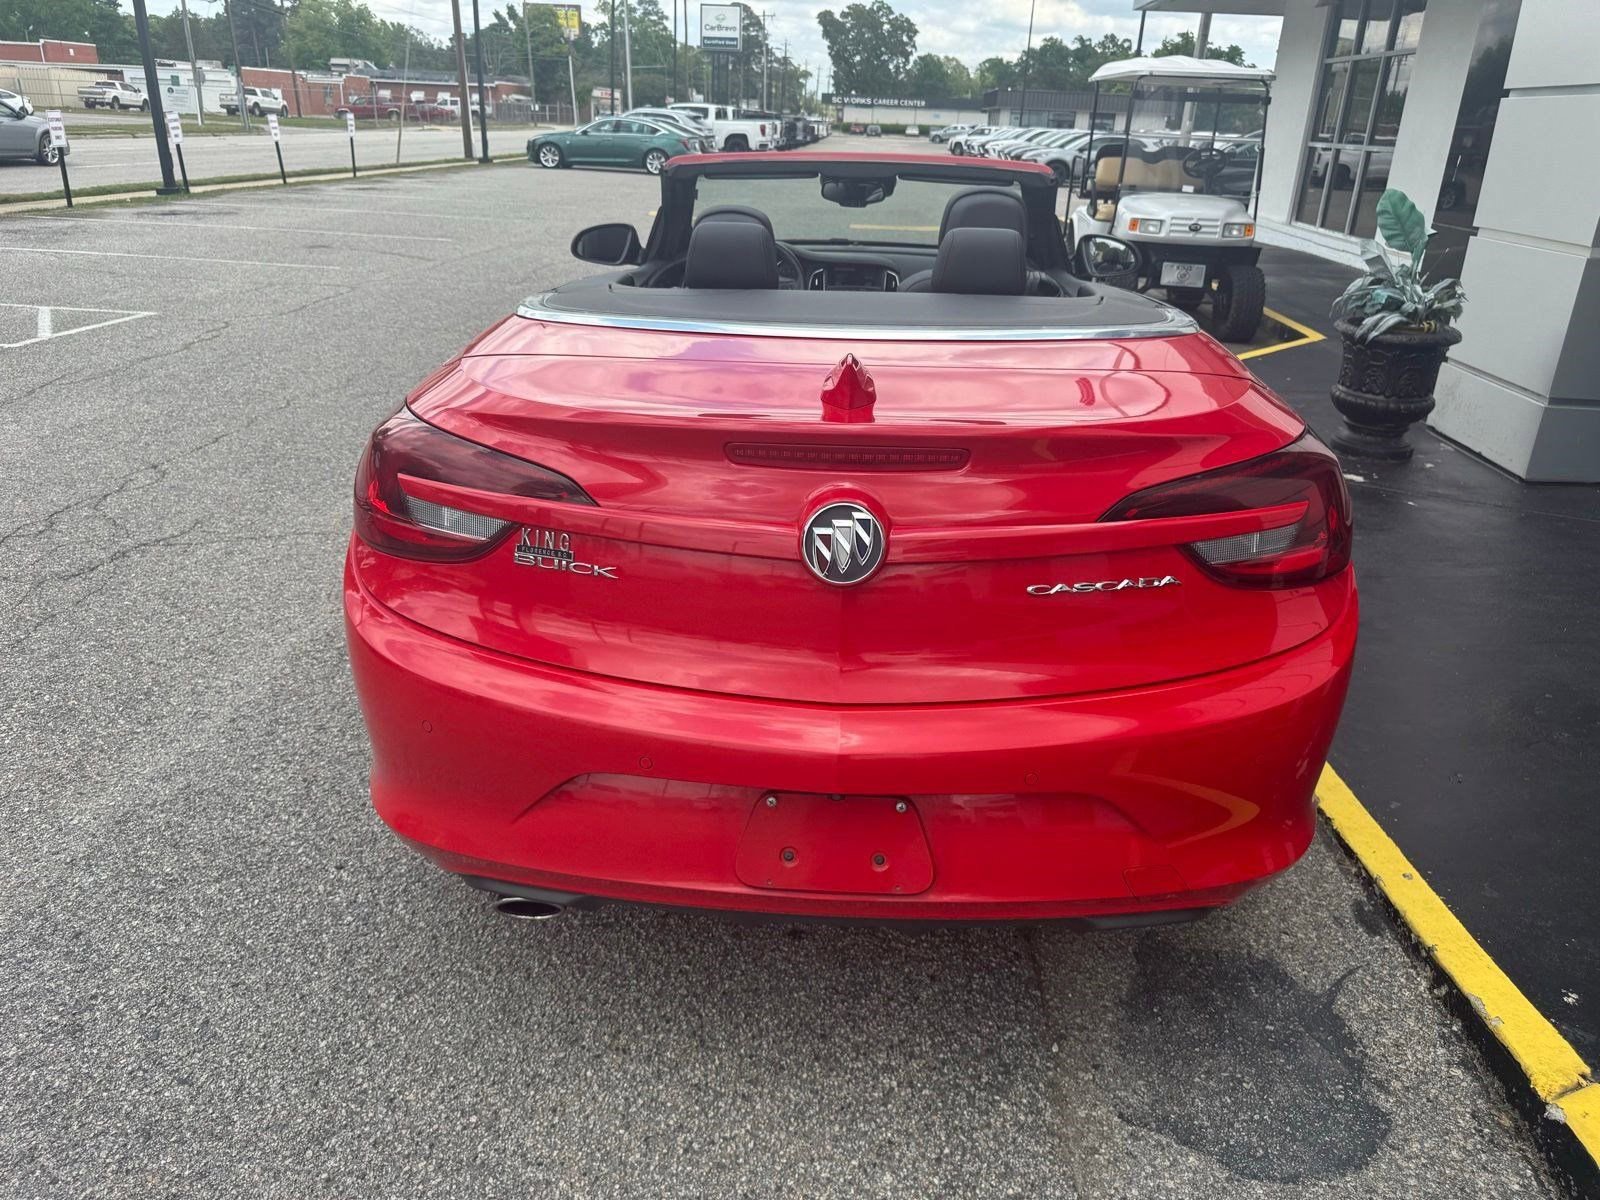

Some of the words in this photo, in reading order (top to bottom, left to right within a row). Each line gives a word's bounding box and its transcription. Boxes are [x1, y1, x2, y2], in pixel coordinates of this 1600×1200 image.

[704, 24, 737, 32] CarBravo
[831, 96, 842, 104] SC
[843, 97, 872, 105] WORKS
[873, 98, 899, 106] CAREER
[899, 98, 926, 107] CENTER
[521, 527, 571, 552] KING
[521, 546, 556, 557] FLORENCE
[513, 552, 620, 579] BUICK
[1026, 575, 1182, 595] CASCADA
